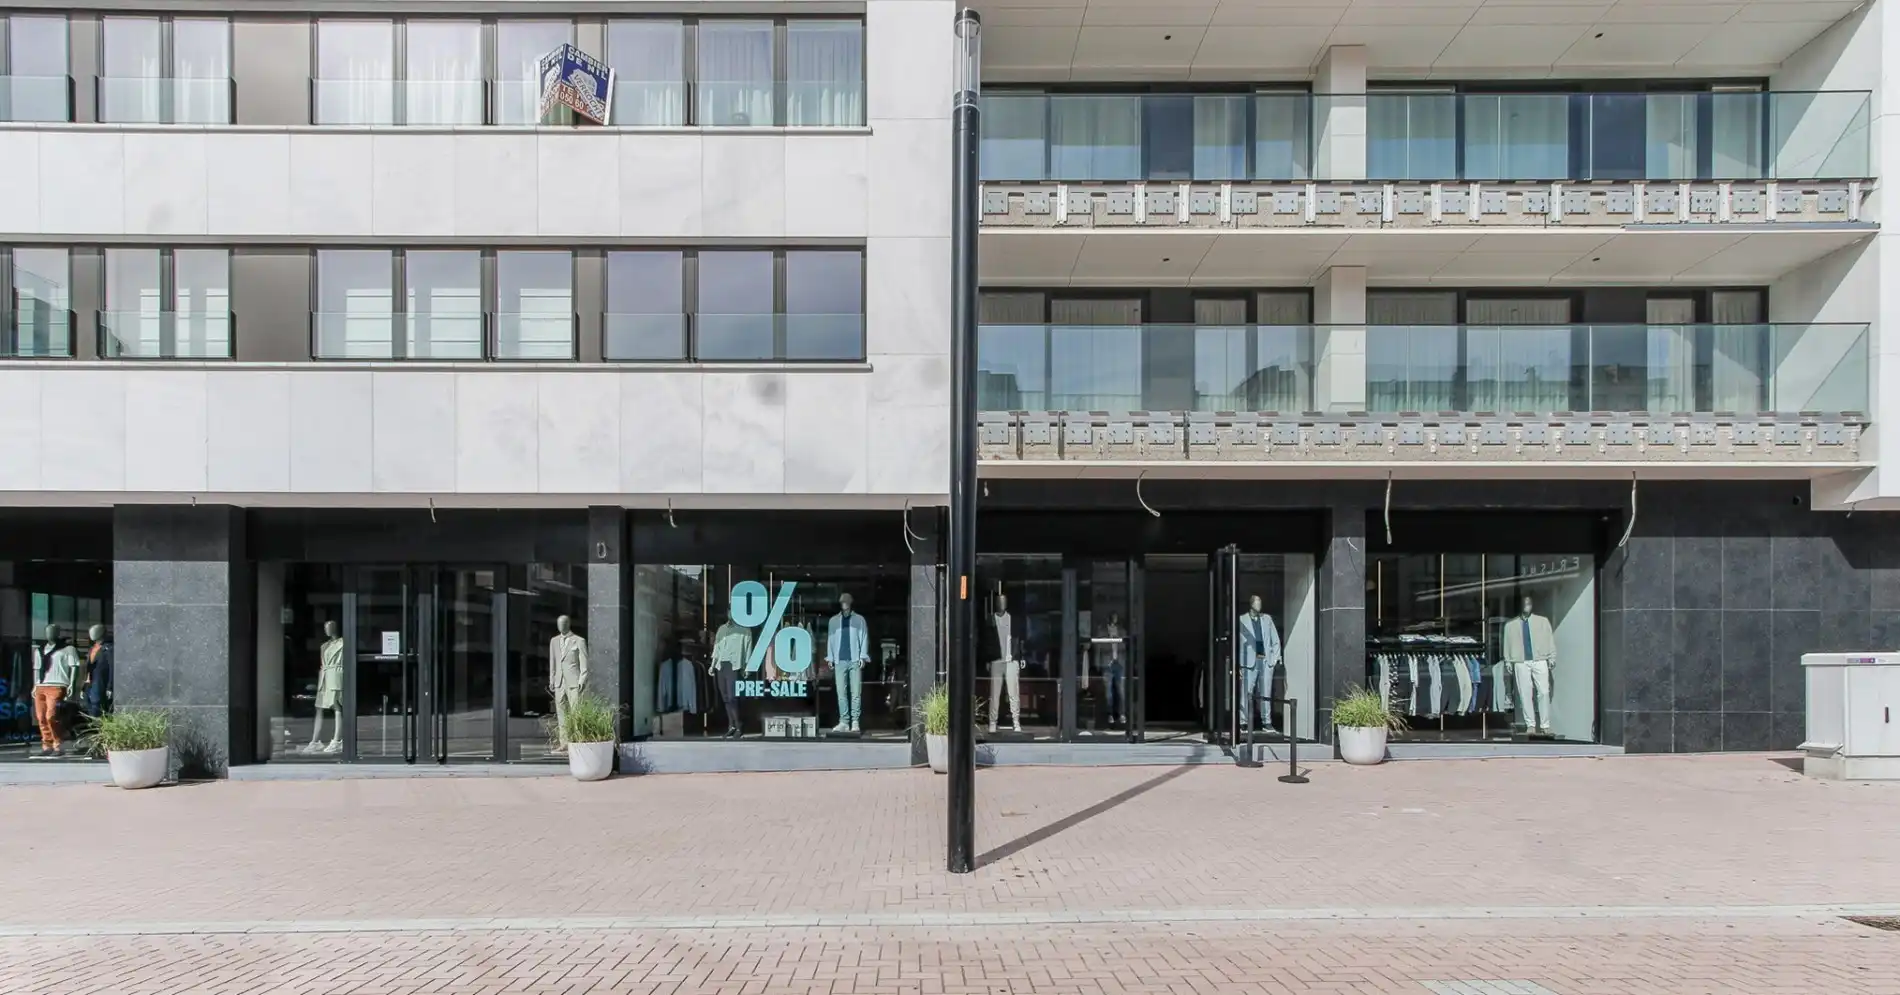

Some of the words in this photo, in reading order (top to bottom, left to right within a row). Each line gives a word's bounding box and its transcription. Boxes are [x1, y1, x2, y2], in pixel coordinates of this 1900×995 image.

[567, 53, 583, 67] DE
[587, 64, 607, 80] NIL
[568, 46, 608, 74] CAMBIER
[573, 73, 602, 115] VERKOCHT
[735, 680, 807, 697] PRE-SALE
